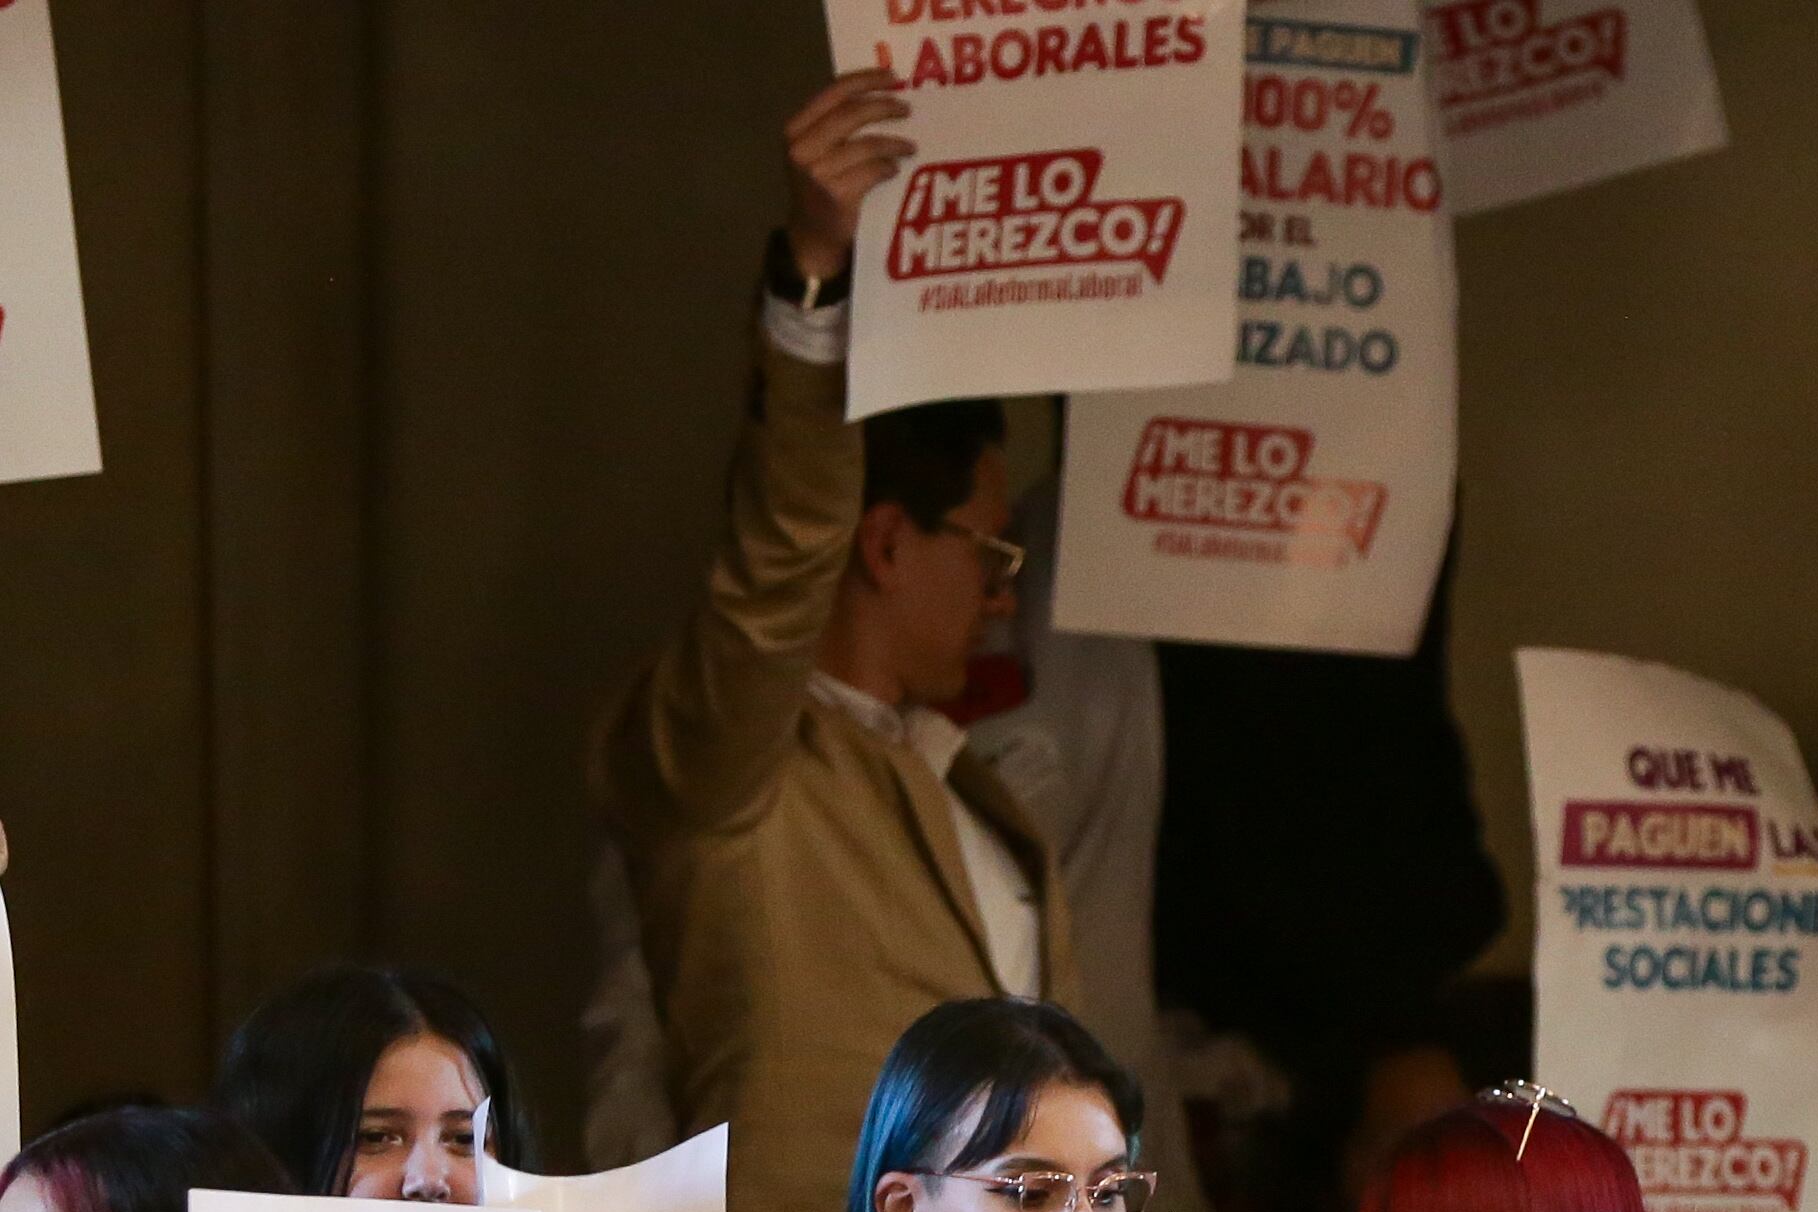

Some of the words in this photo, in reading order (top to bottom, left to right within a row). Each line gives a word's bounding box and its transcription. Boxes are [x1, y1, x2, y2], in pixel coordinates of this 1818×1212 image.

[906, 166, 1001, 221] ¡ME
[1012, 157, 1086, 210] LO
[901, 203, 1174, 273] MEREZCO!
[1233, 432, 1298, 477] LO
[1136, 474, 1378, 530] MEREZCO!
[1628, 746, 1702, 792] QUE
[1582, 810, 1748, 862] PAGUEN
[1604, 944, 1800, 993] SOCIALES
[1680, 1098, 1736, 1141] LO
